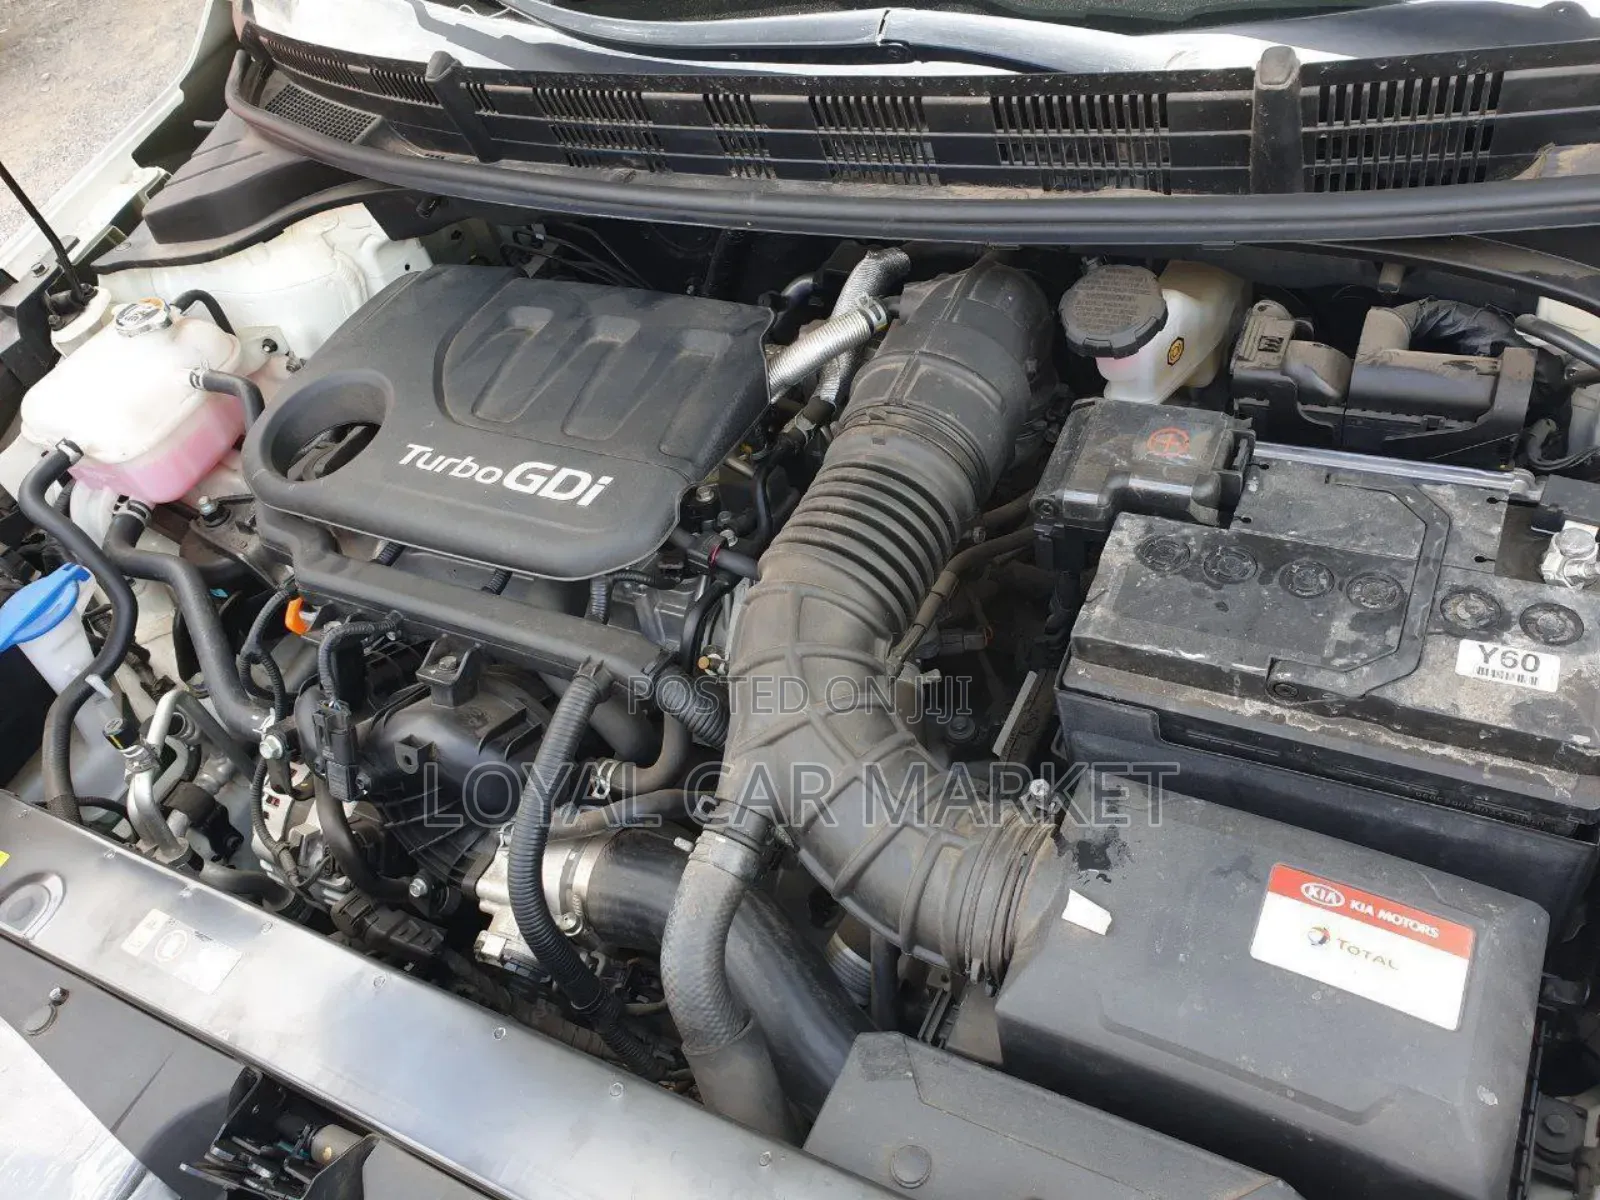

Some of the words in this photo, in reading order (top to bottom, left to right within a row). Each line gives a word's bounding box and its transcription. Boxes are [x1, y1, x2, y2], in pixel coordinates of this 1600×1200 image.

[1478, 644, 1541, 673] Y60
[1308, 886, 1338, 905] KIA
[1350, 899, 1375, 917] KIA
[1377, 909, 1440, 940] MOTORS
[1336, 938, 1399, 970] TOTAL
